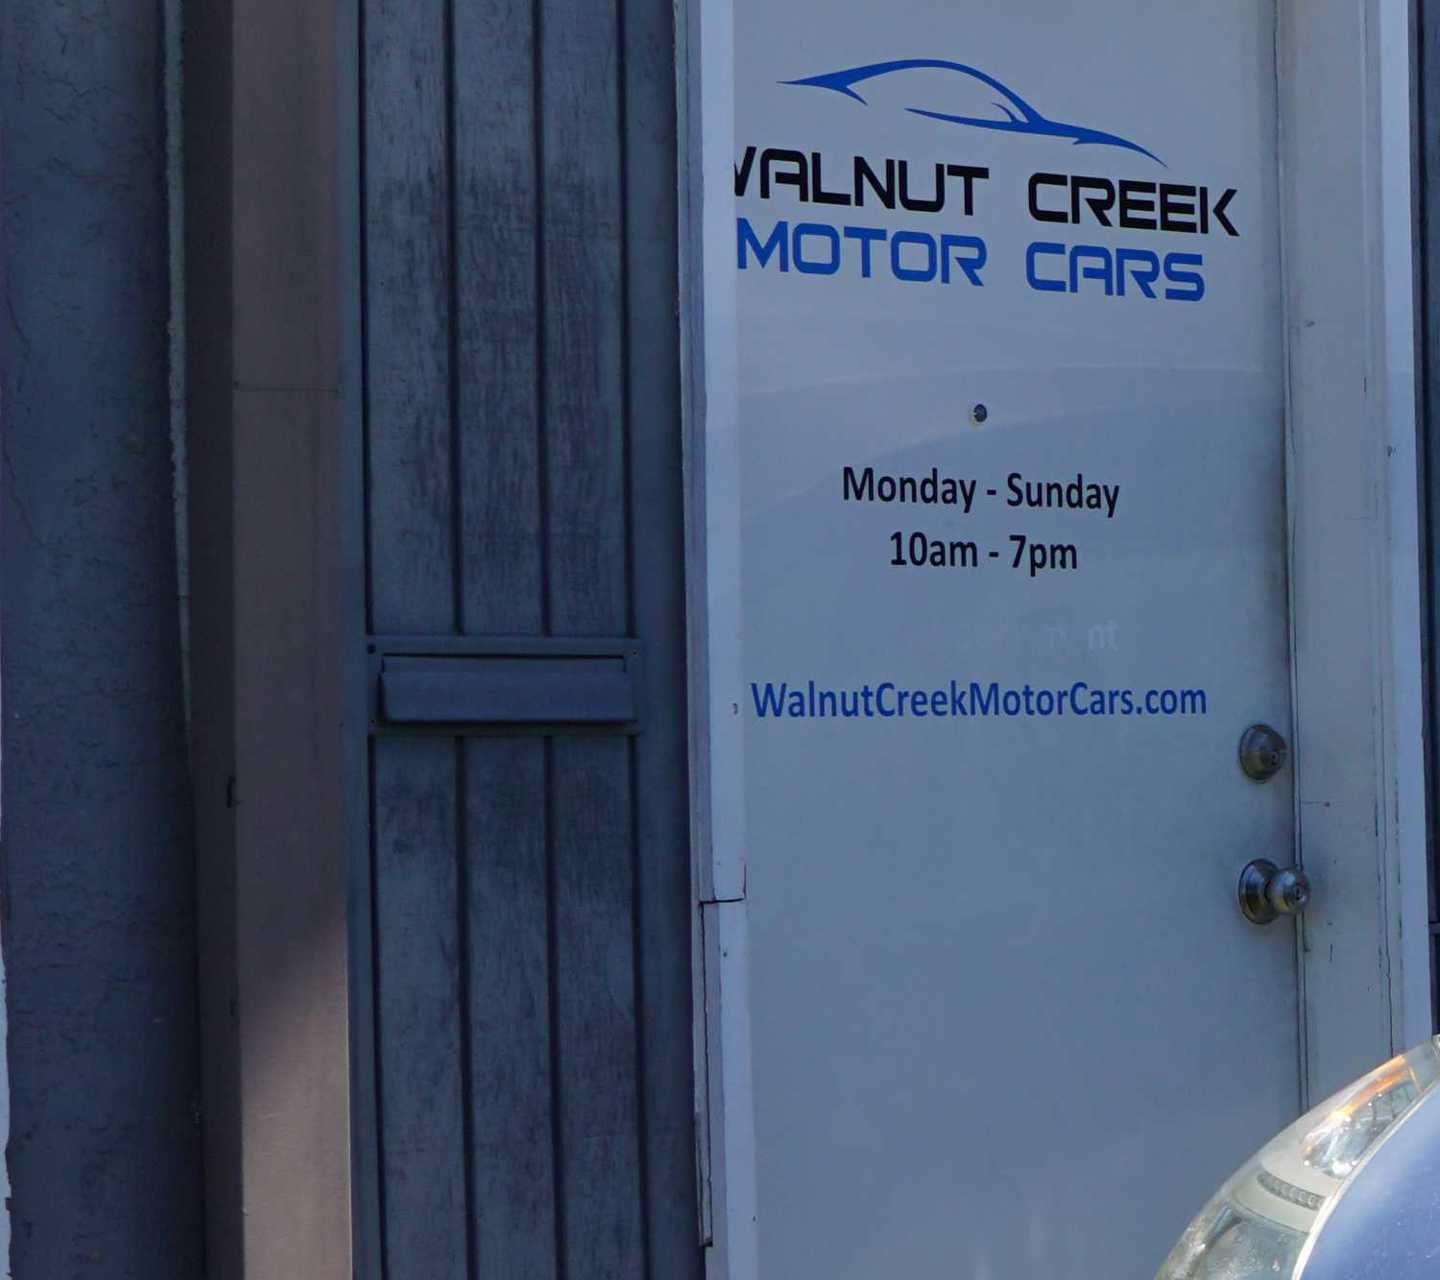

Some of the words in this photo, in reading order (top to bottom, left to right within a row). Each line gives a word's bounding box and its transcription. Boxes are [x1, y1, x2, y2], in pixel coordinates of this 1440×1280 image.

[1028, 172, 1240, 237] CREEK
[737, 217, 987, 287] MOTOR
[1026, 241, 1205, 302] CARS
[842, 465, 977, 513] Monday
[1006, 472, 1120, 519] Sunday
[890, 532, 978, 568] 10am
[1009, 534, 1078, 578] 7pm
[751, 679, 1207, 718] WalnutCreekMotorCars.com
